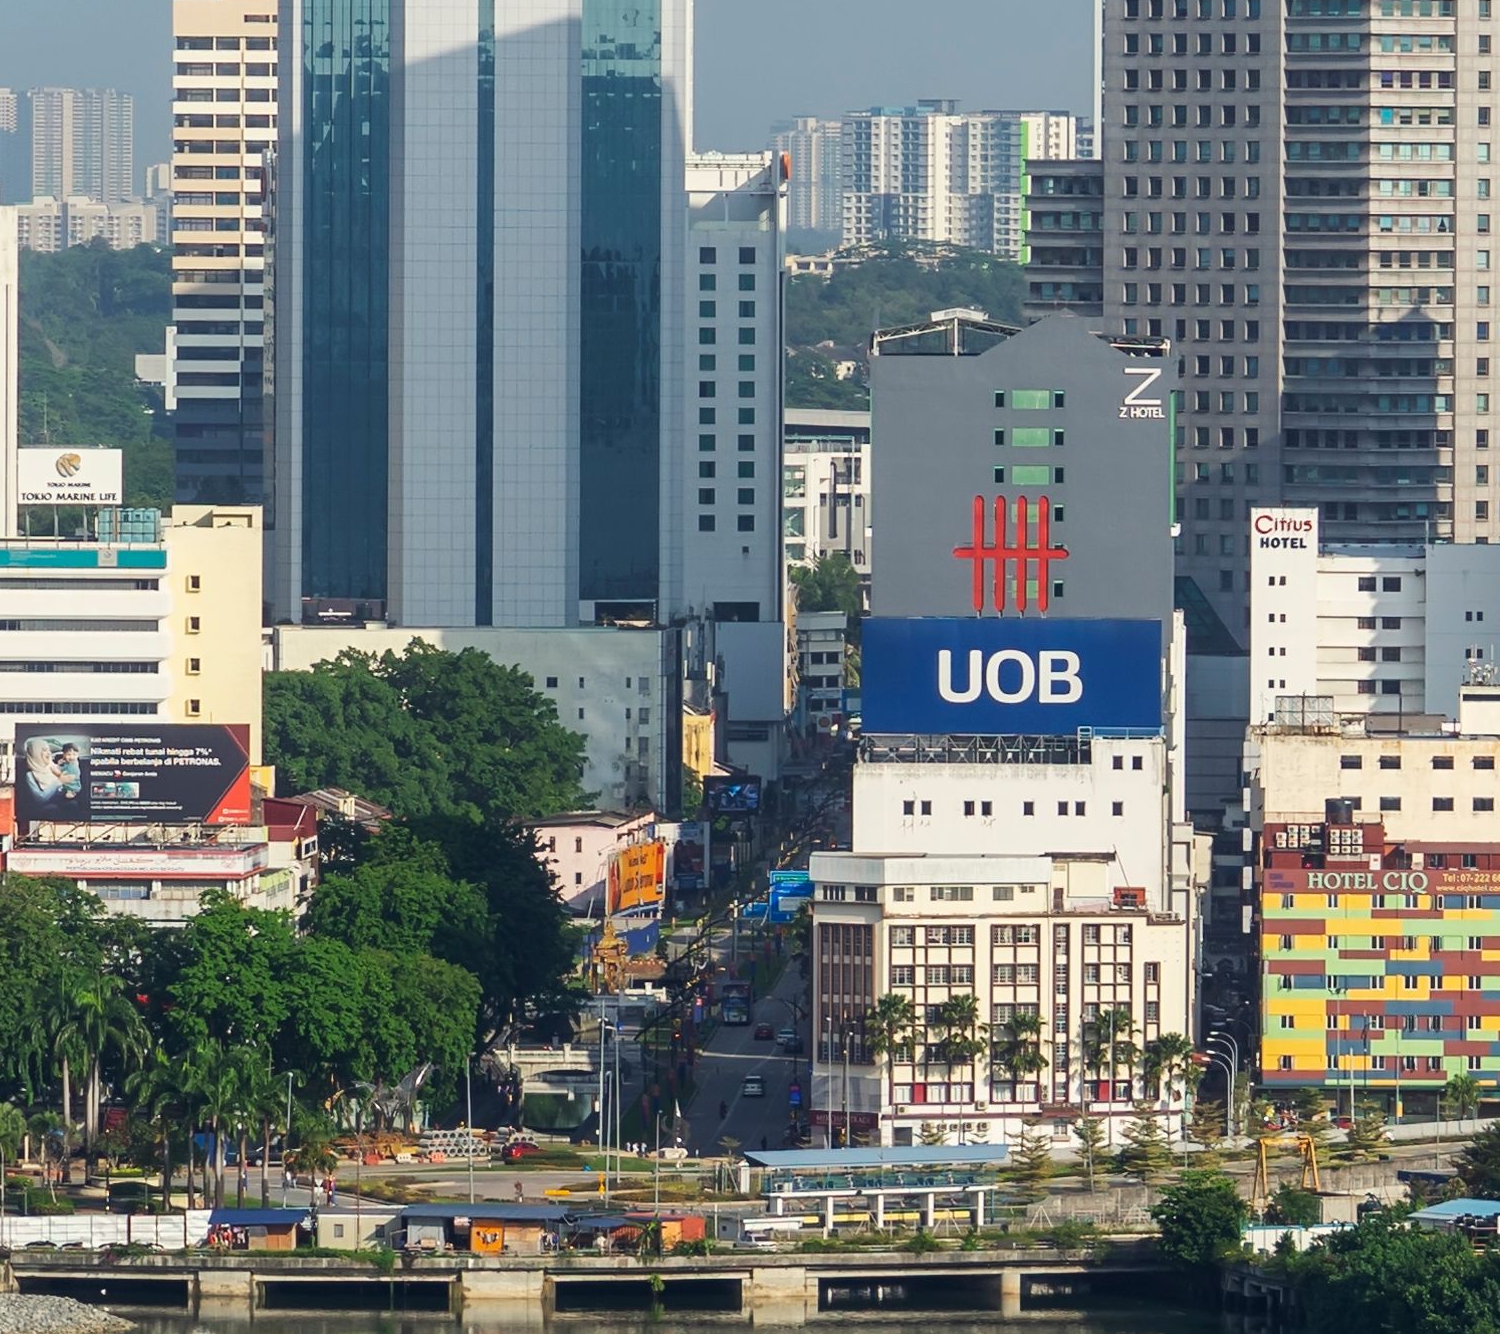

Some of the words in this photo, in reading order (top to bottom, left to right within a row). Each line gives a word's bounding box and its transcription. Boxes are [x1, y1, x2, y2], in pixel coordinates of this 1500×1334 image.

[1124, 367, 1161, 405] Z
[1119, 407, 1127, 418] Z
[1130, 407, 1165, 418] HOTEL
[22, 493, 52, 501] TOKIO
[56, 493, 96, 501] MARINE
[100, 493, 117, 501] LIFE
[1255, 515, 1312, 534] Citrus
[1260, 537, 1307, 548] HOTEL
[937, 649, 1083, 704] UOB
[167, 748, 194, 756] hingga
[90, 758, 119, 766] apabila
[121, 758, 162, 766] berbelanja
[174, 758, 221, 766] PETRONAS.
[1307, 873, 1378, 889] HOTEL
[1383, 873, 1429, 894] CIQ
